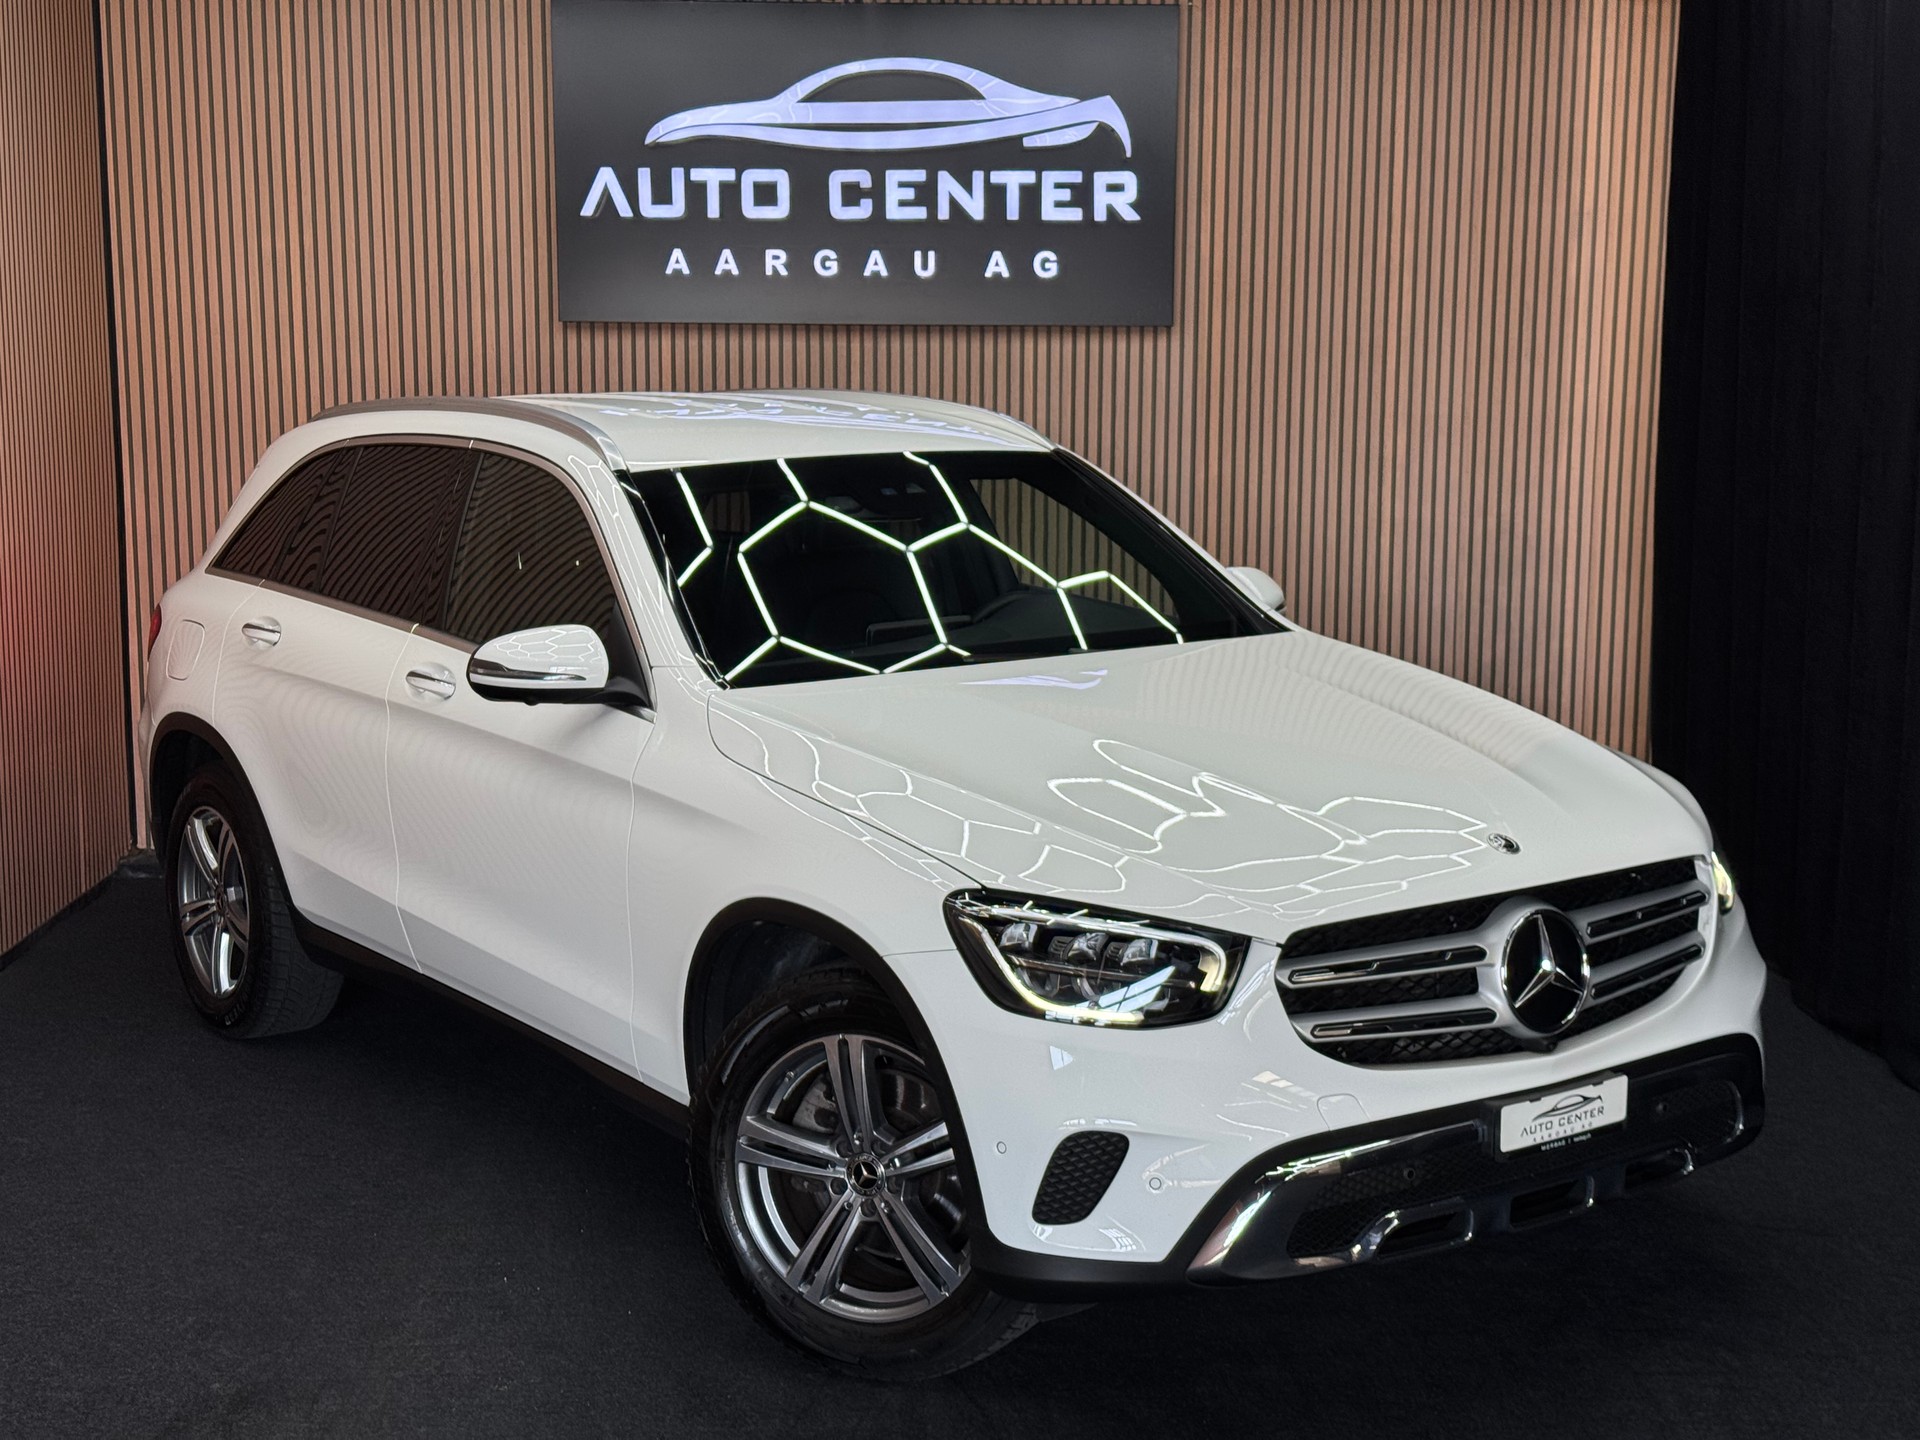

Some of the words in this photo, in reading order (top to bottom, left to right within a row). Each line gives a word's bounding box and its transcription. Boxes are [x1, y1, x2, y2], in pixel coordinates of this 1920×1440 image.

[579, 166, 791, 220] AUTO
[828, 169, 1141, 222] CENTER
[665, 247, 936, 279] AARGAU
[984, 250, 1059, 279] AG
[1520, 1120, 1554, 1138] AUTO
[1558, 1106, 1605, 1128] CENTER
